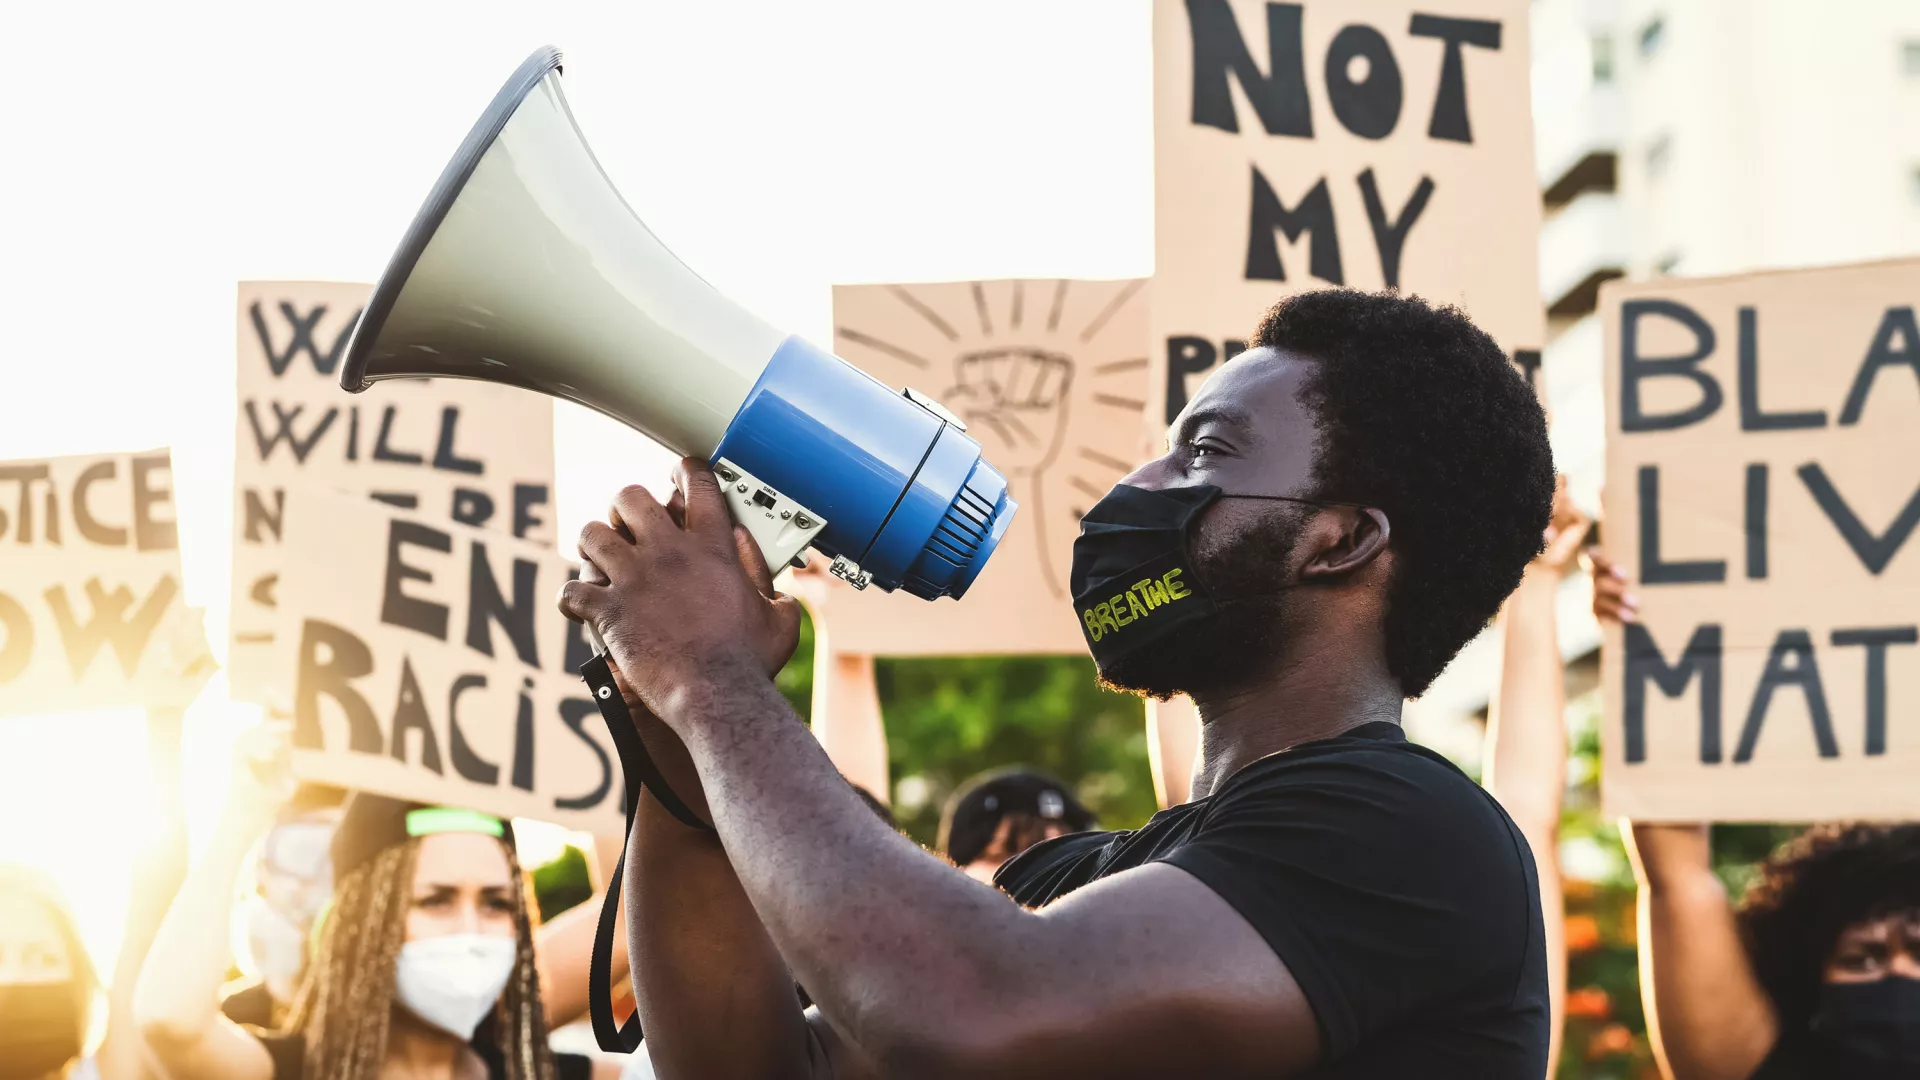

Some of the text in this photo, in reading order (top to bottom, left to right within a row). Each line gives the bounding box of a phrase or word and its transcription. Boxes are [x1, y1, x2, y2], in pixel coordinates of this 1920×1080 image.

[1185, 0, 1503, 144] NOT
[1244, 160, 1436, 289] MY
[1619, 299, 1920, 432] BLA
[244, 399, 485, 475] WILL
[762, 485, 777, 497] SIREN
[0, 455, 178, 552] TiCE
[765, 512, 775, 520] OFF
[1637, 462, 1920, 585] LIV
[1083, 567, 1192, 642] BREATHE
[293, 617, 627, 817] RACiS
[1622, 624, 1918, 764] MAT
